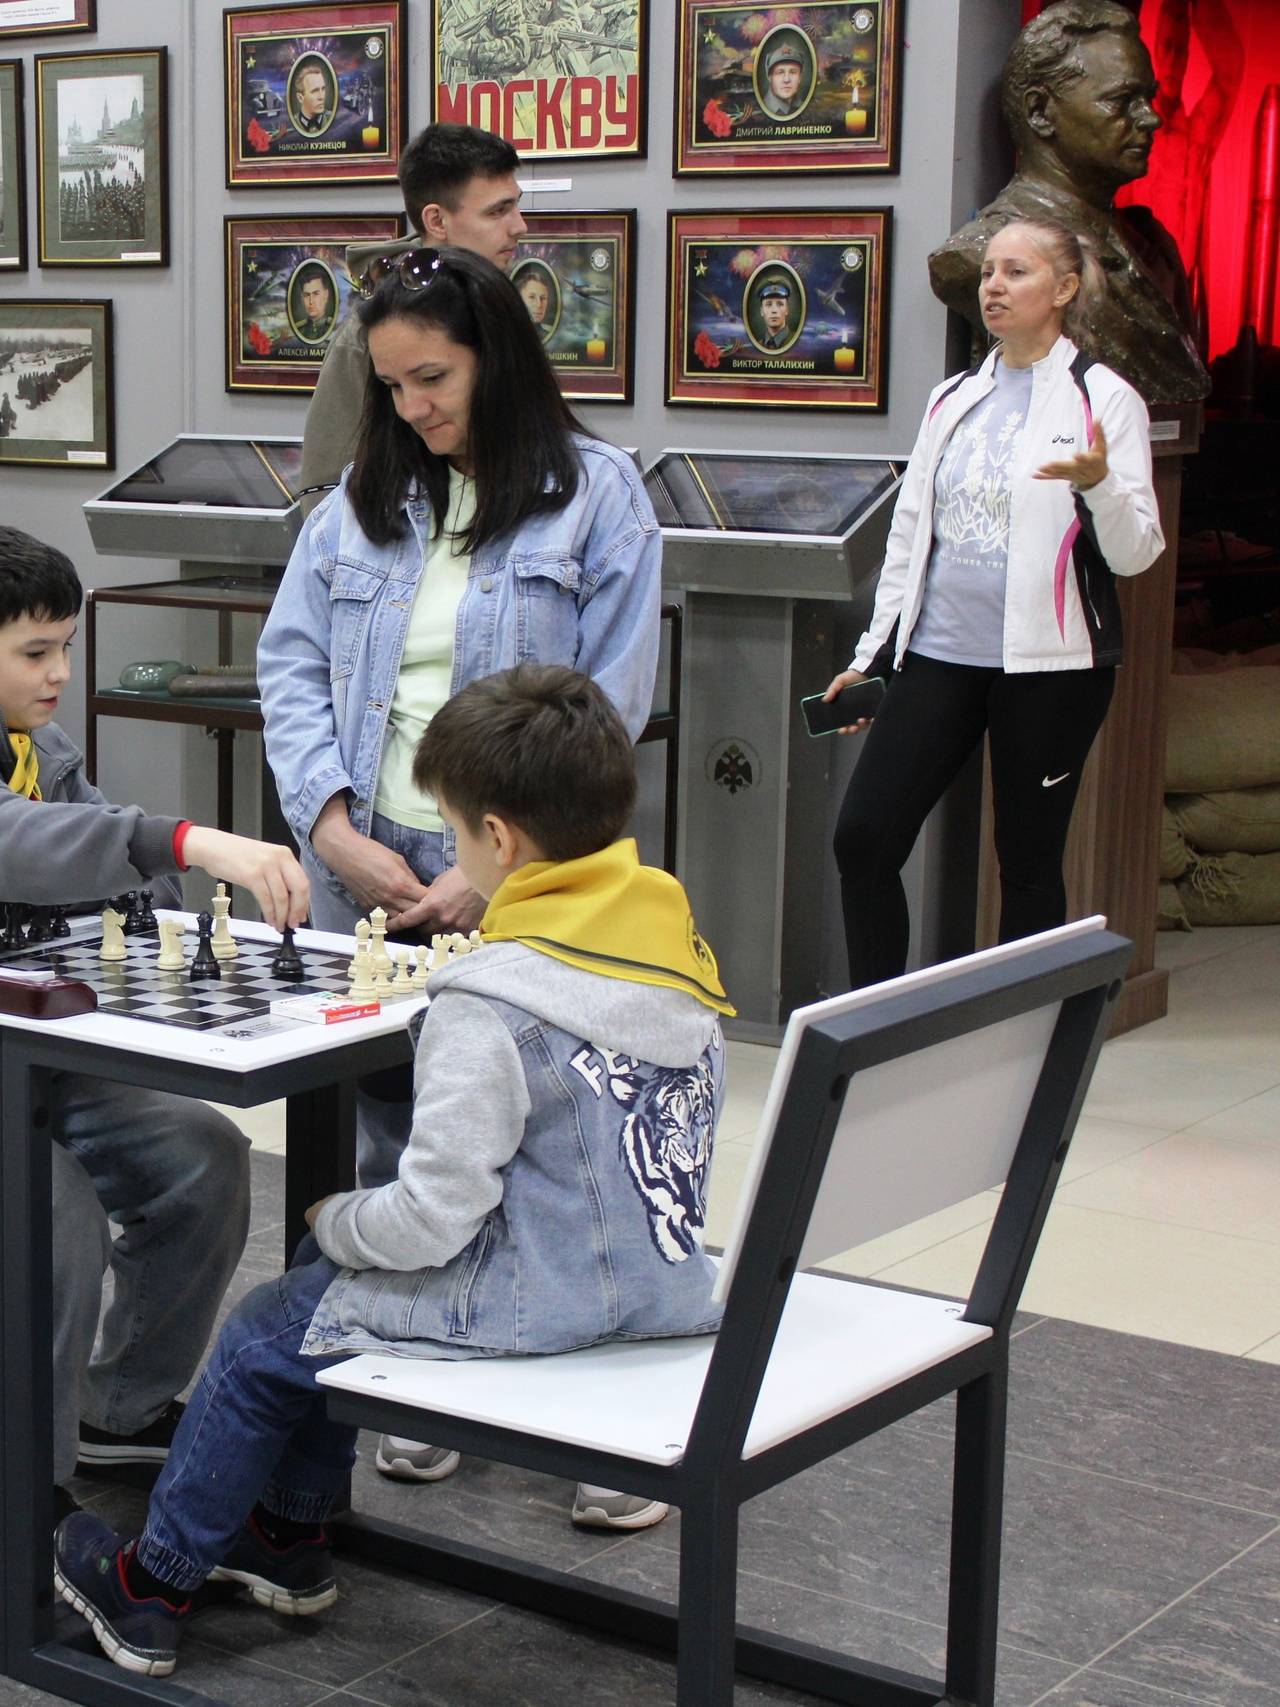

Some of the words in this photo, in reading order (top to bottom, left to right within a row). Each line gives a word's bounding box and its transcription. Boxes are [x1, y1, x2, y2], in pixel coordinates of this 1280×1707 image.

[438, 74, 638, 149] МОСКВУ
[774, 125, 832, 136] ЛАВРИНЕНКО
[309, 141, 347, 151] КУЗНЕЦОВ
[278, 348, 308, 357] АЛЕКСЕЙ
[309, 349, 327, 357] МАР
[546, 352, 578, 361] ЫШКИН
[732, 359, 762, 369] ВИКТОР
[764, 360, 815, 370] ТАЛАЛИХИН
